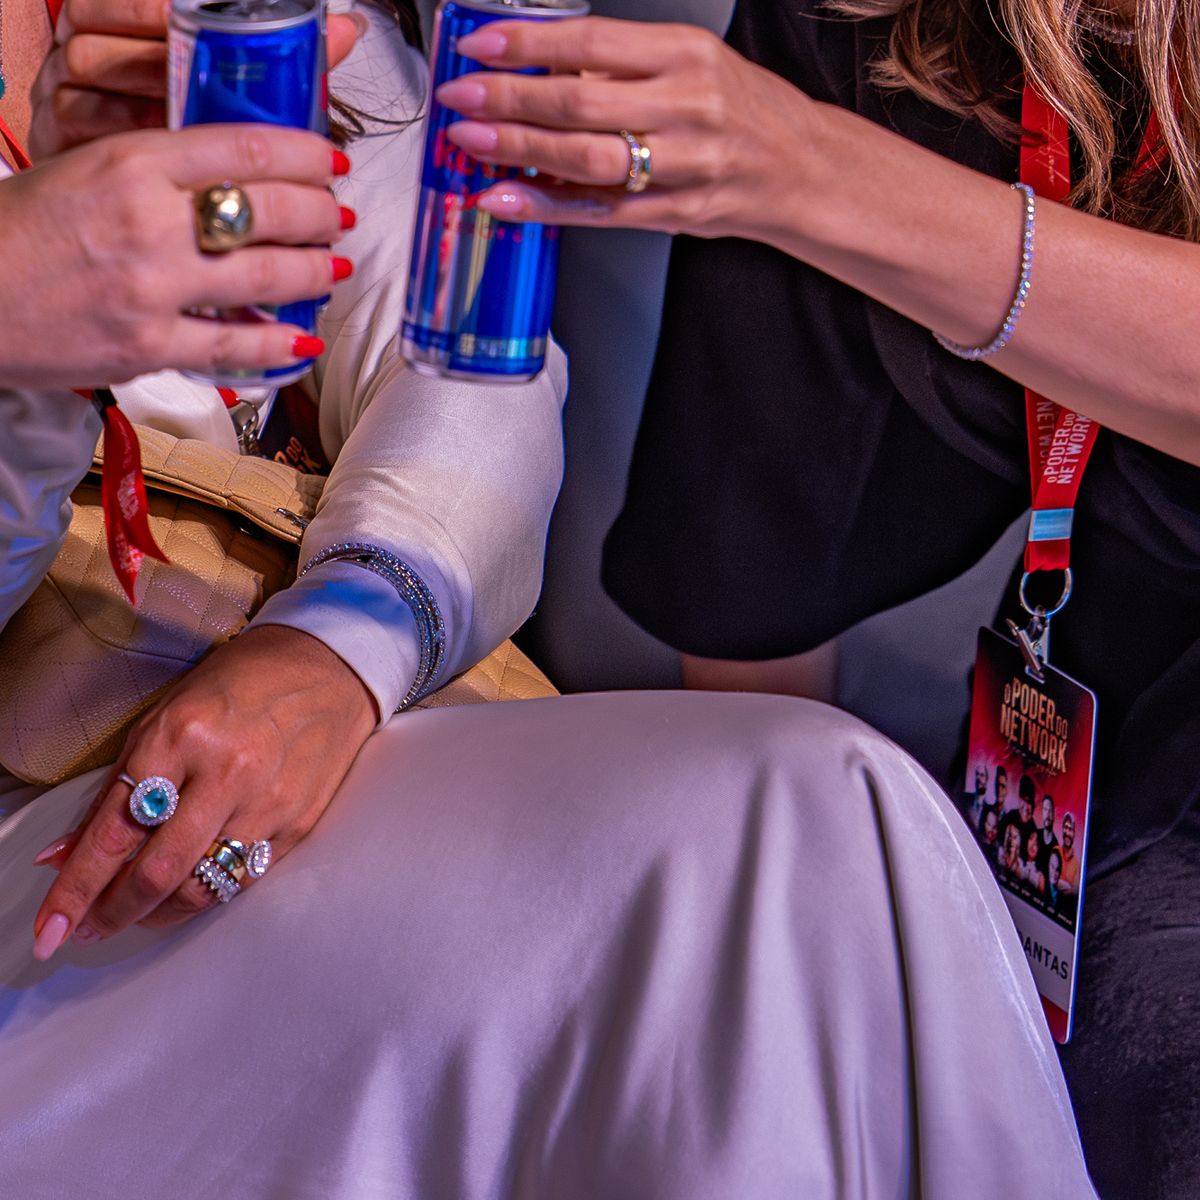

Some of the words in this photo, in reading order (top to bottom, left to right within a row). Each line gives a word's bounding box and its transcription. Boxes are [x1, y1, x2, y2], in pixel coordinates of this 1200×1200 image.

[1043, 428, 1071, 476] PODER
[1056, 413, 1092, 485] NETWORK
[1011, 676, 1056, 732] PODER
[1000, 703, 1068, 774] NETWORK
